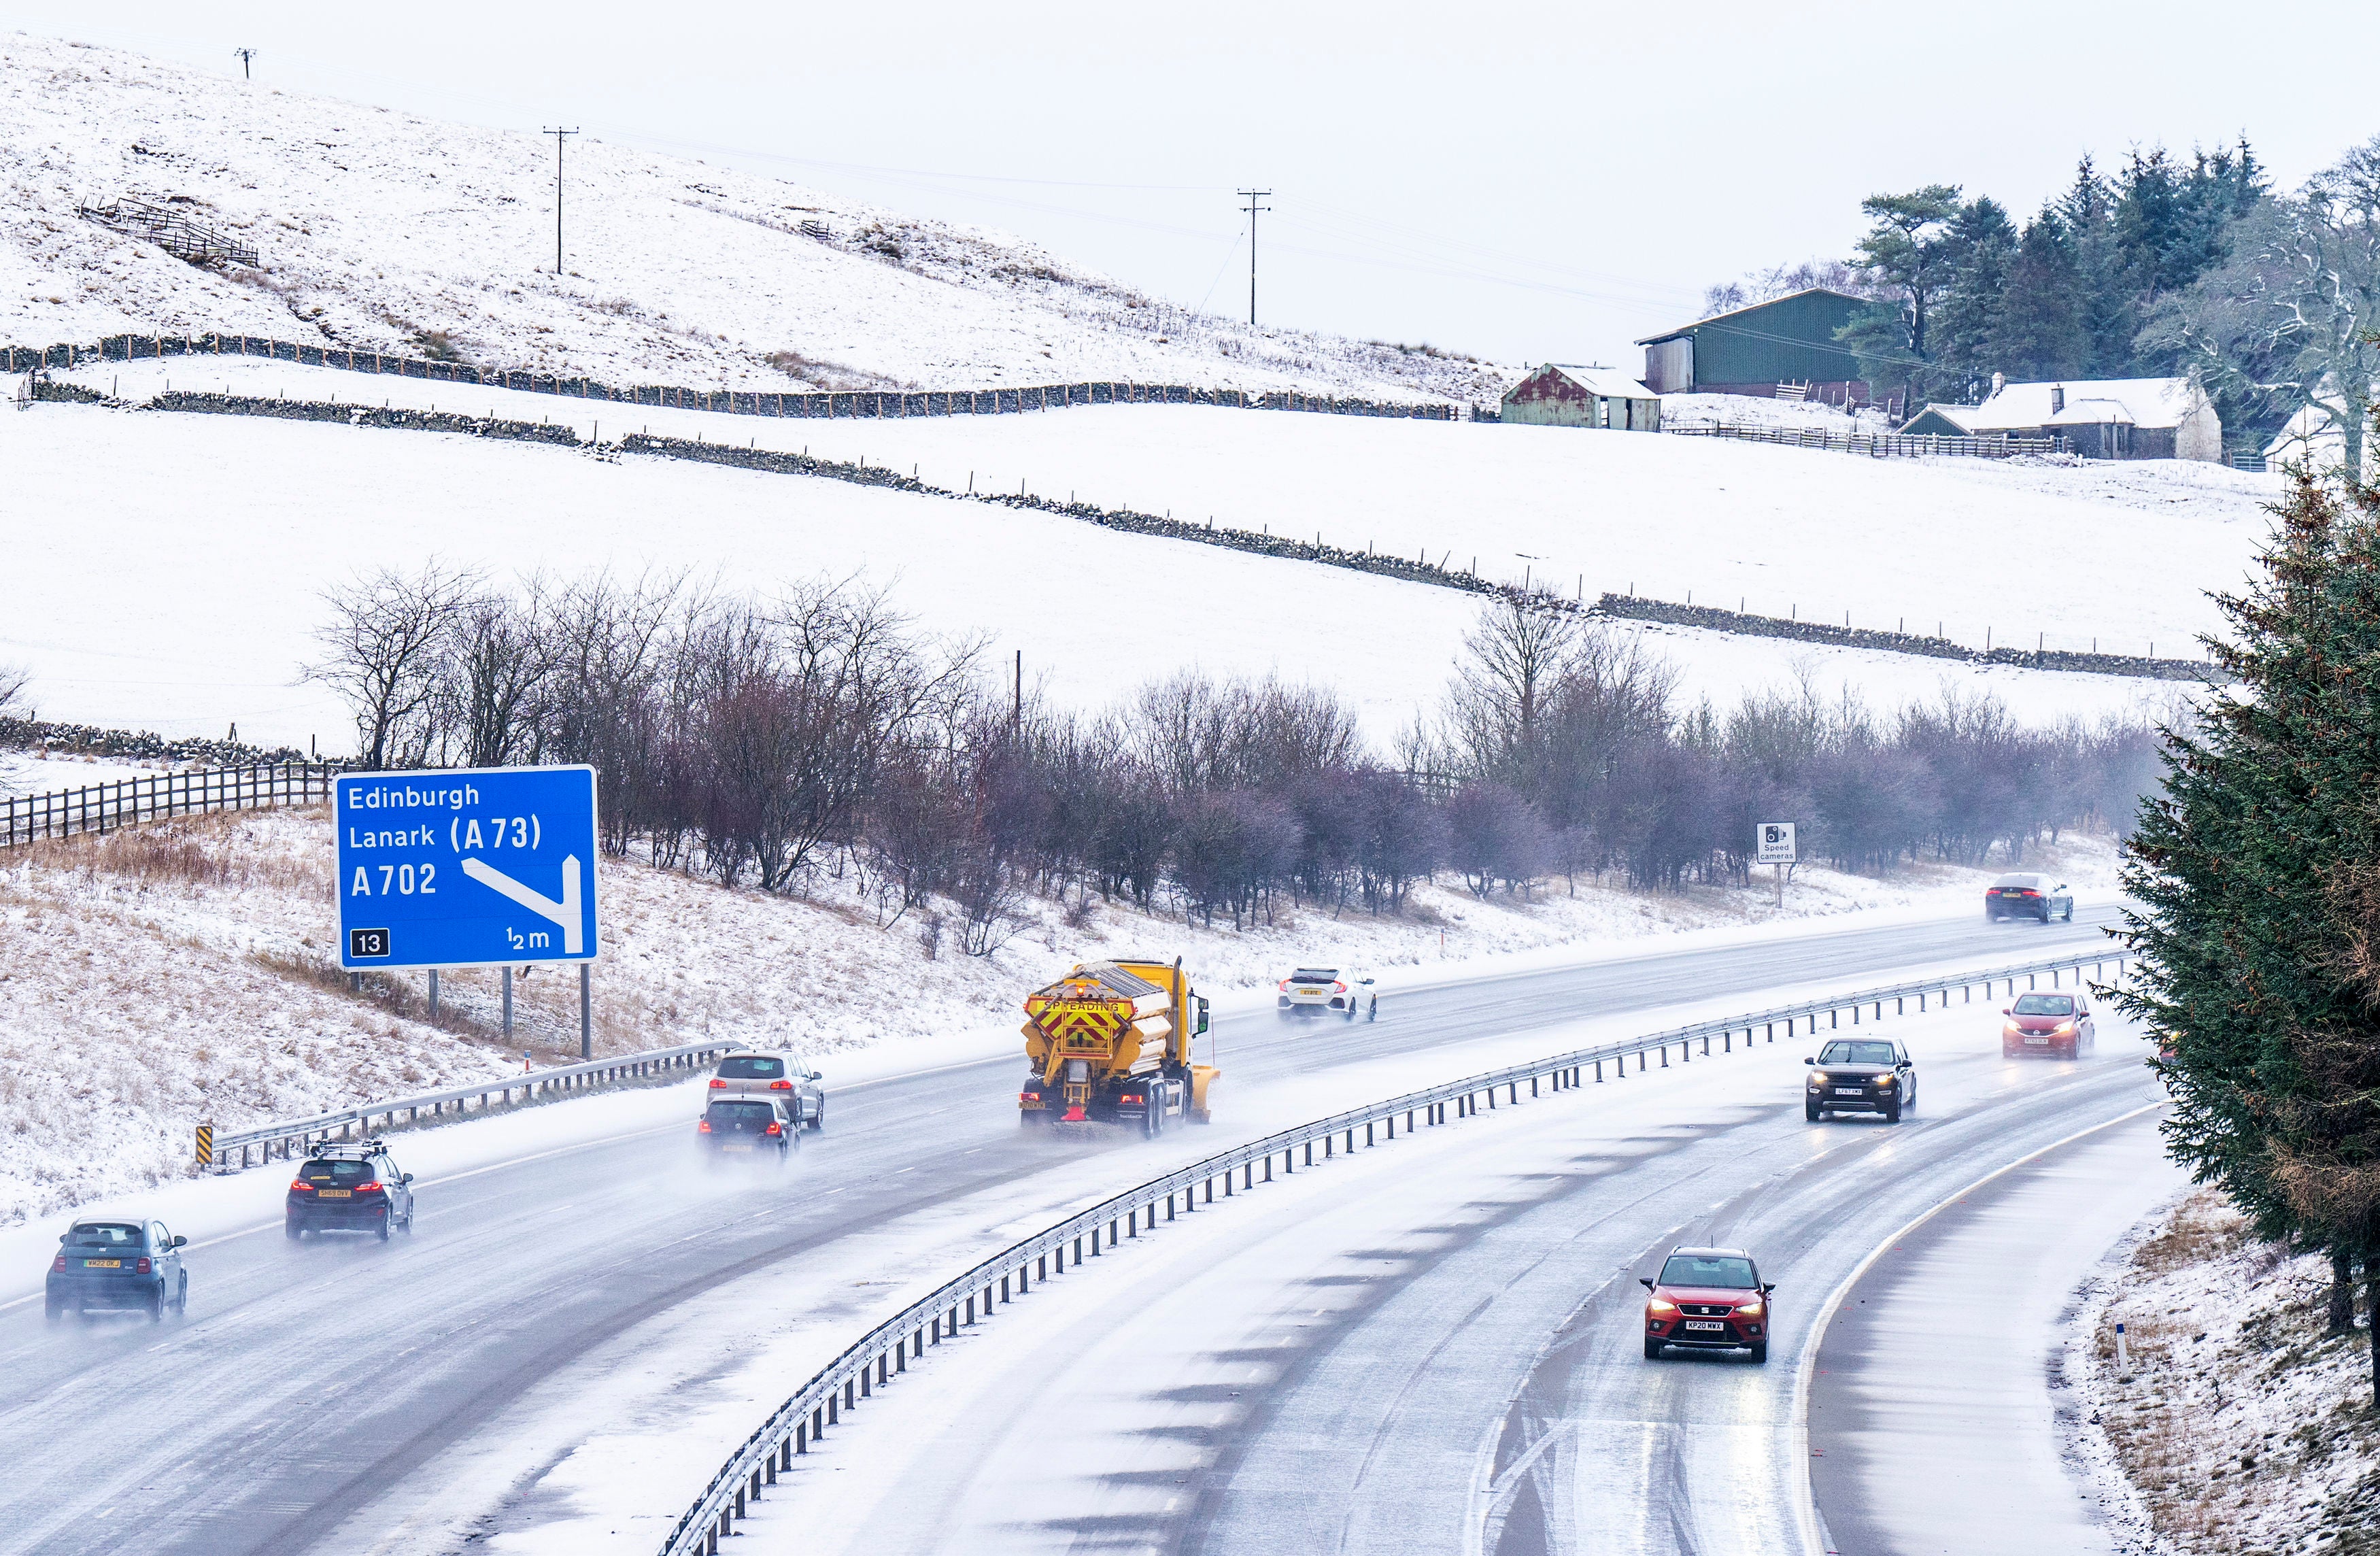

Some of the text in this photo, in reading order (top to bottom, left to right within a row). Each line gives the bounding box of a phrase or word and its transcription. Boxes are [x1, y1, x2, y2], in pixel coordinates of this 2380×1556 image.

[350, 783, 479, 809] Edinburgh
[350, 824, 435, 848] Lanark
[1765, 844, 1789, 852] Speed
[359, 934, 381, 953] 13
